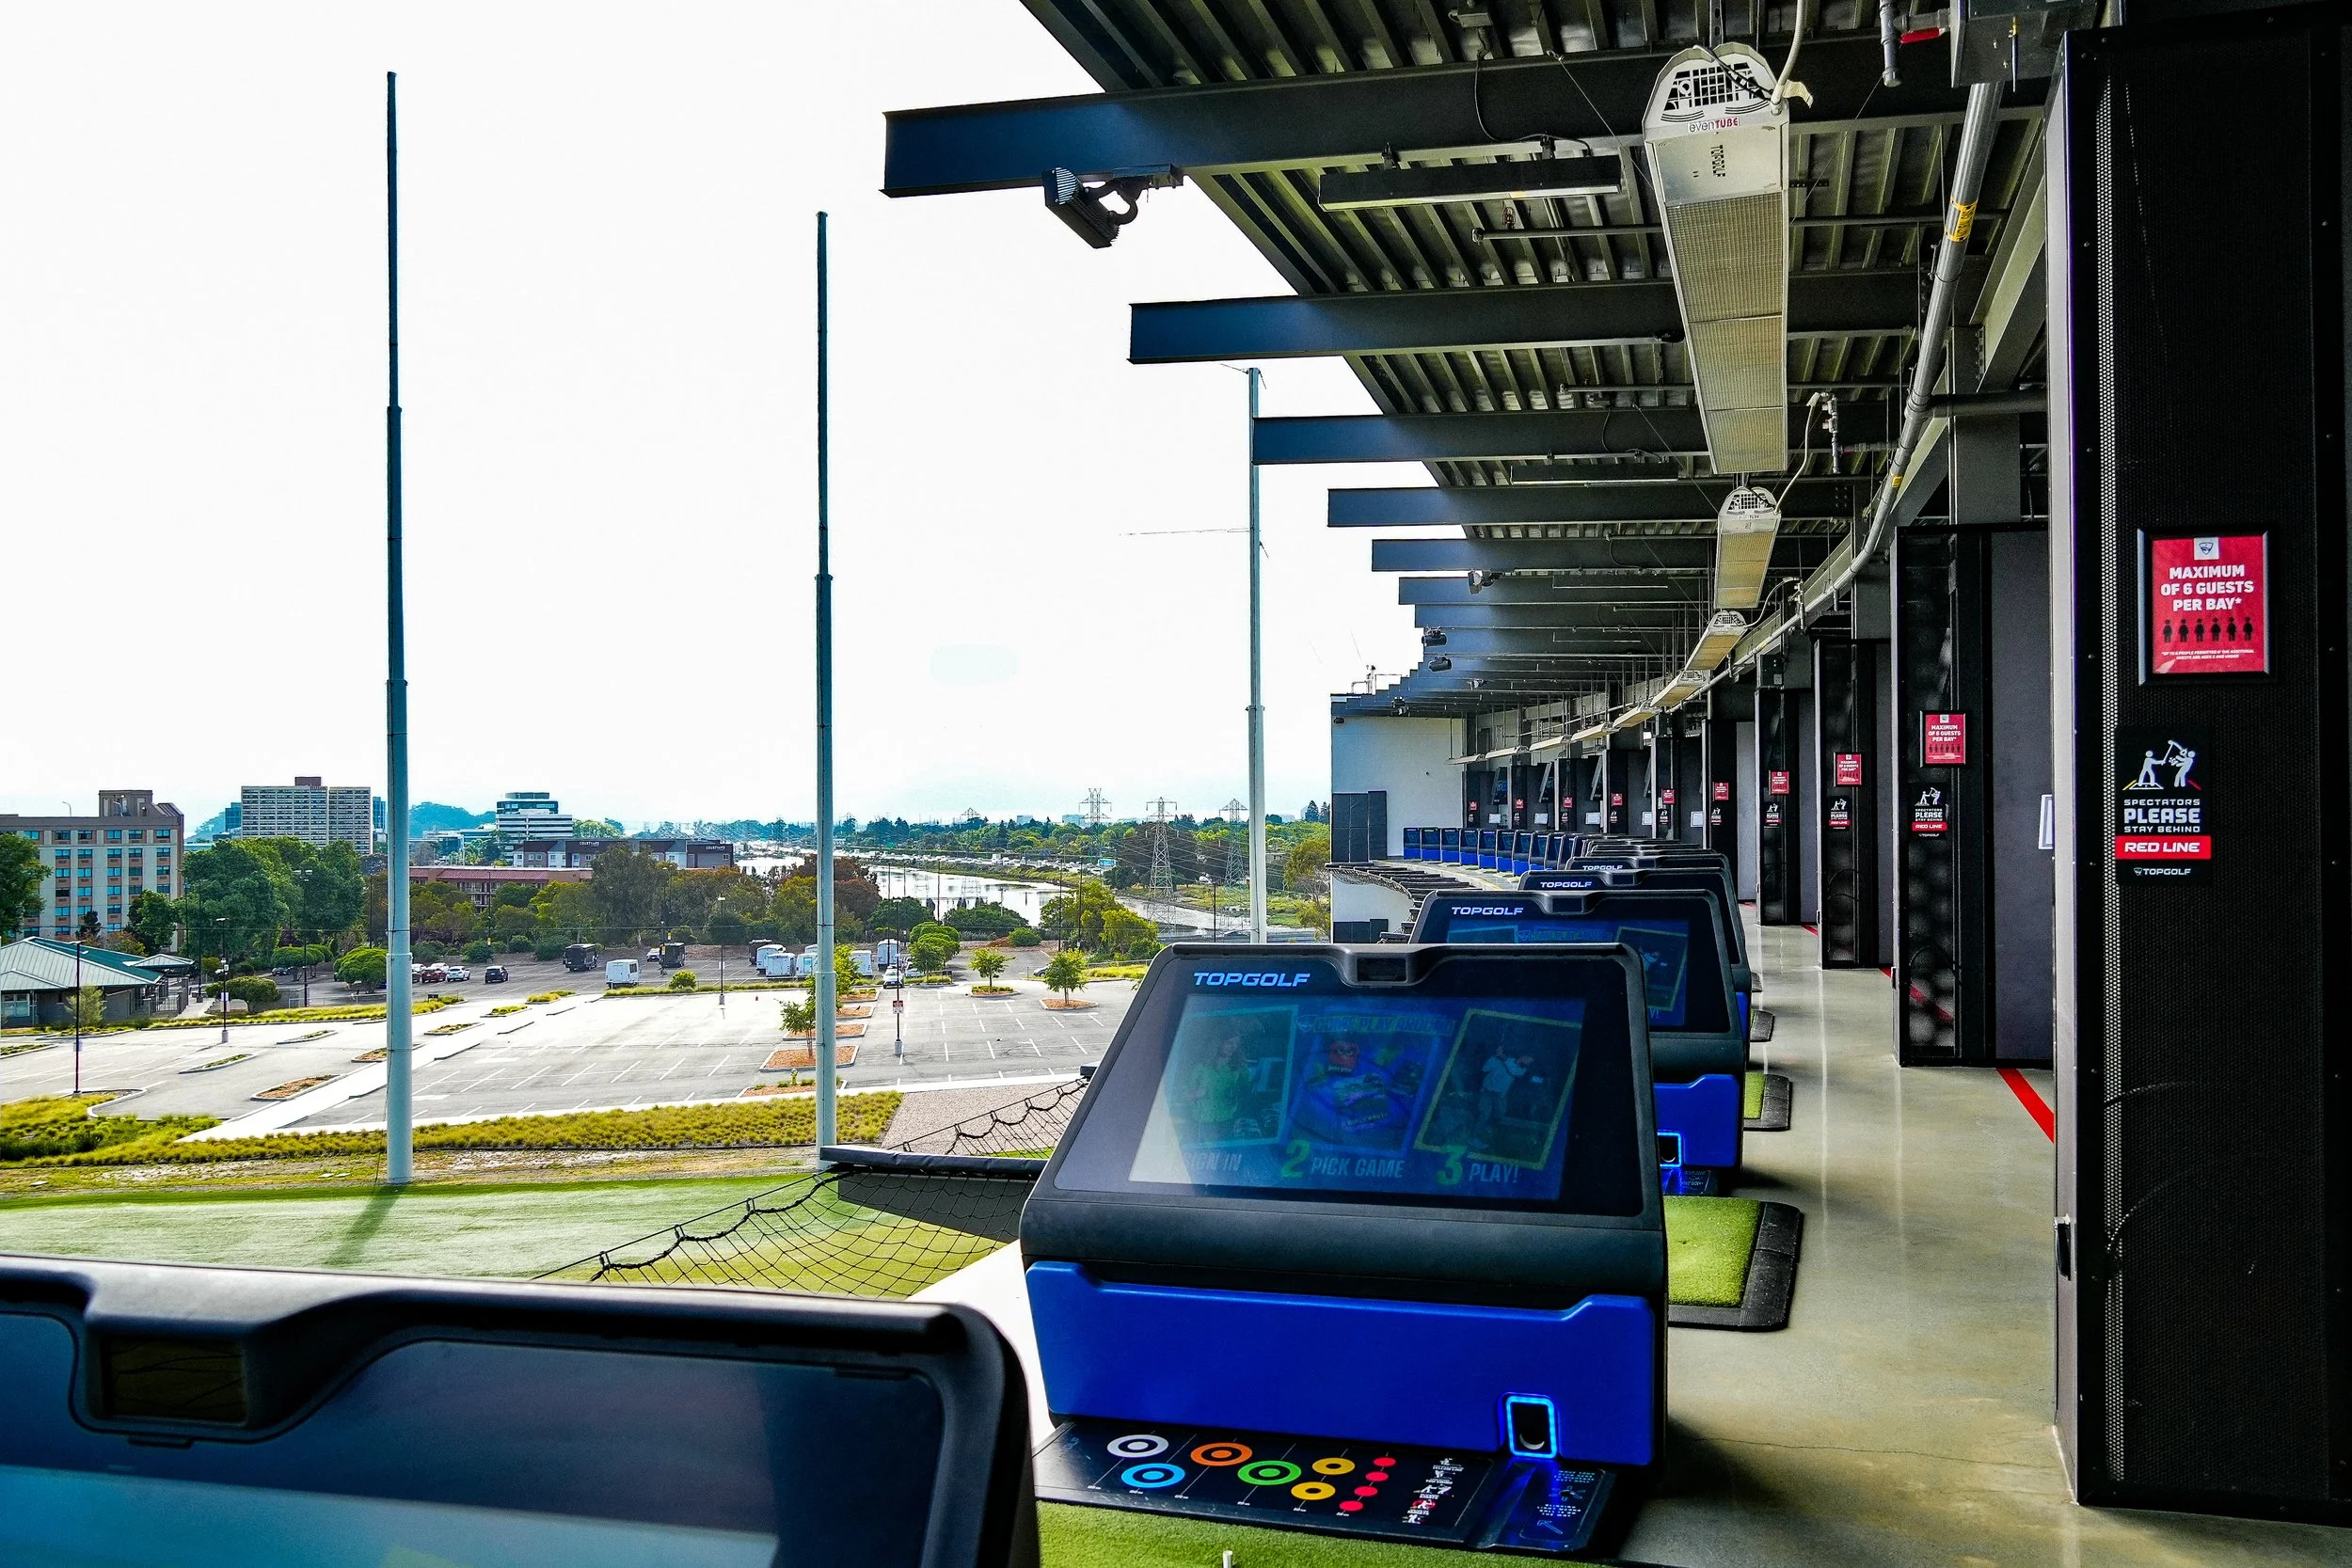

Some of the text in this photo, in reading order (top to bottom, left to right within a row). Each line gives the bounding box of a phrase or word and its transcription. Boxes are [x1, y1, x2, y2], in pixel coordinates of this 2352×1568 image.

[1689, 118, 1739, 132] evenTUBE
[2169, 564, 2245, 579] MAXIMUM
[2160, 580, 2254, 595] OF 6 GUESTS
[2172, 599, 2201, 611] PER
[2123, 808, 2201, 824] PLEASE
[2124, 842, 2201, 853] RED LINE
[1452, 907, 1524, 915] TOPGOLF
[1193, 972, 1311, 987] TOPGOLF
[1283, 1140, 1406, 1179] 2 PICK GAME
[1436, 1145, 1520, 1186] 3 PLAY!
